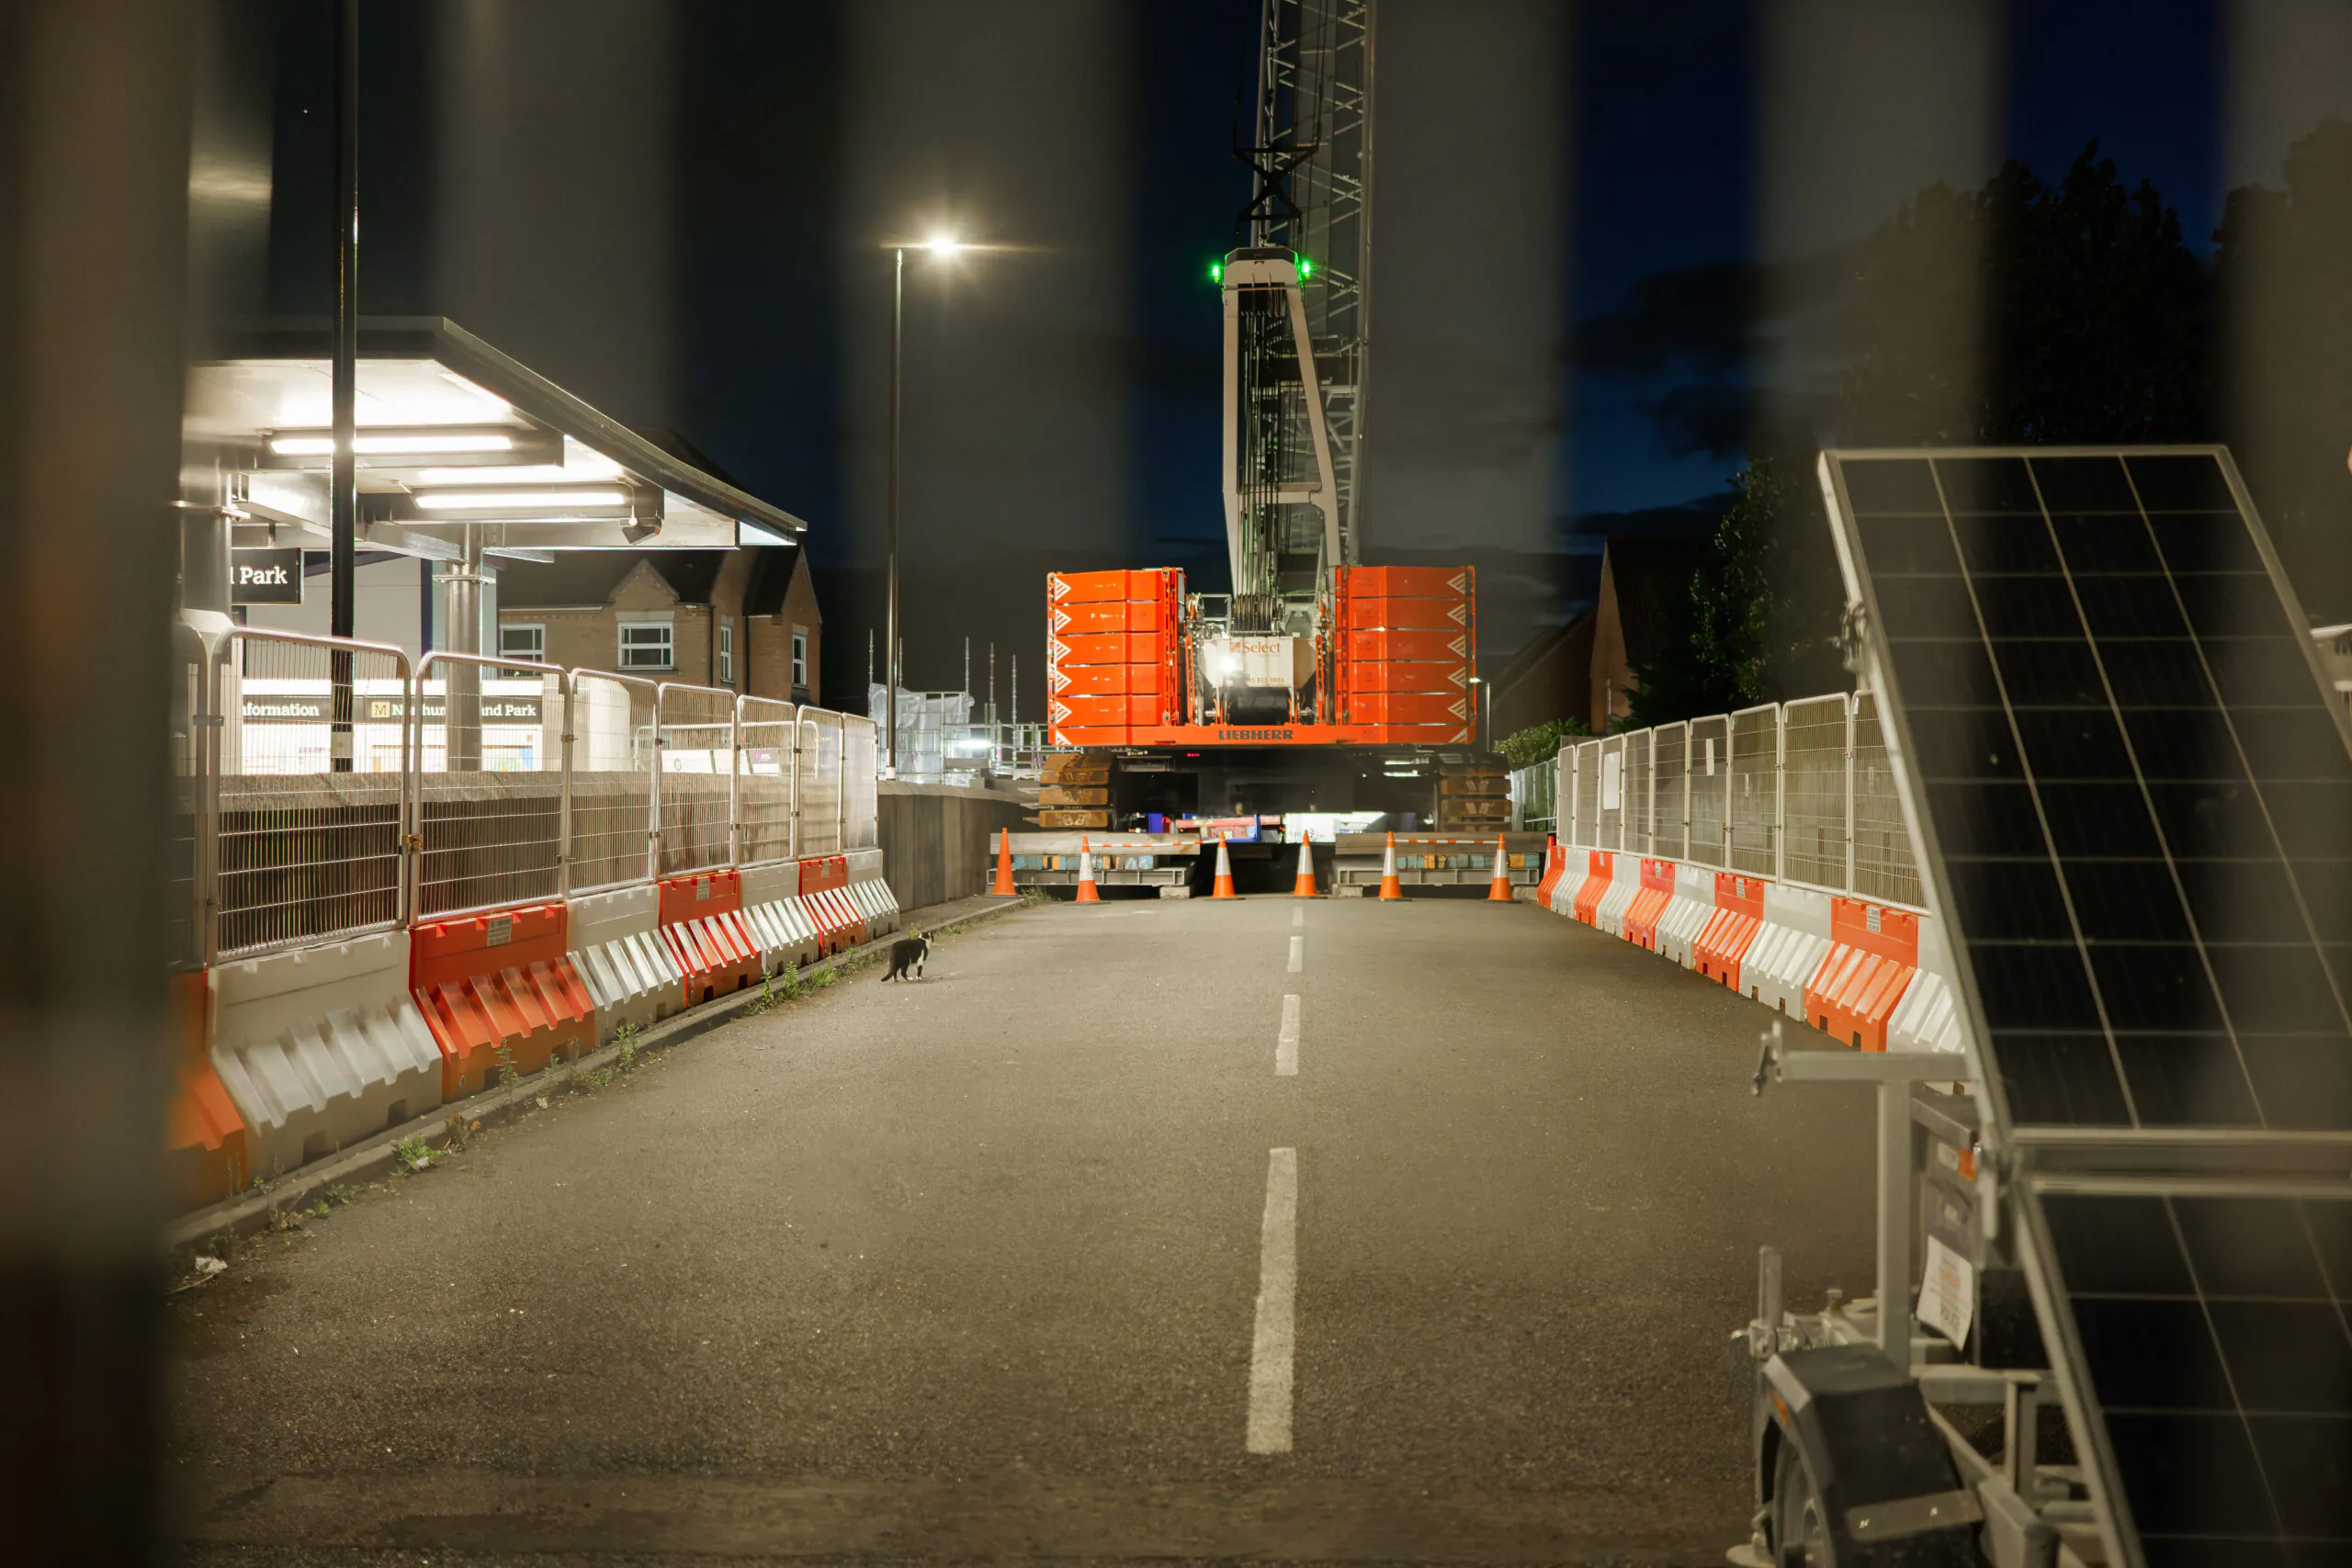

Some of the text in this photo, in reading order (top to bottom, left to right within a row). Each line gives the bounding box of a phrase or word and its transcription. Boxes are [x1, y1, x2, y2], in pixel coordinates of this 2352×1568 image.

[240, 565, 288, 584] Park
[1243, 640, 1281, 653] Select
[505, 704, 537, 716] Park
[1218, 729, 1294, 740] LIEBHERR
